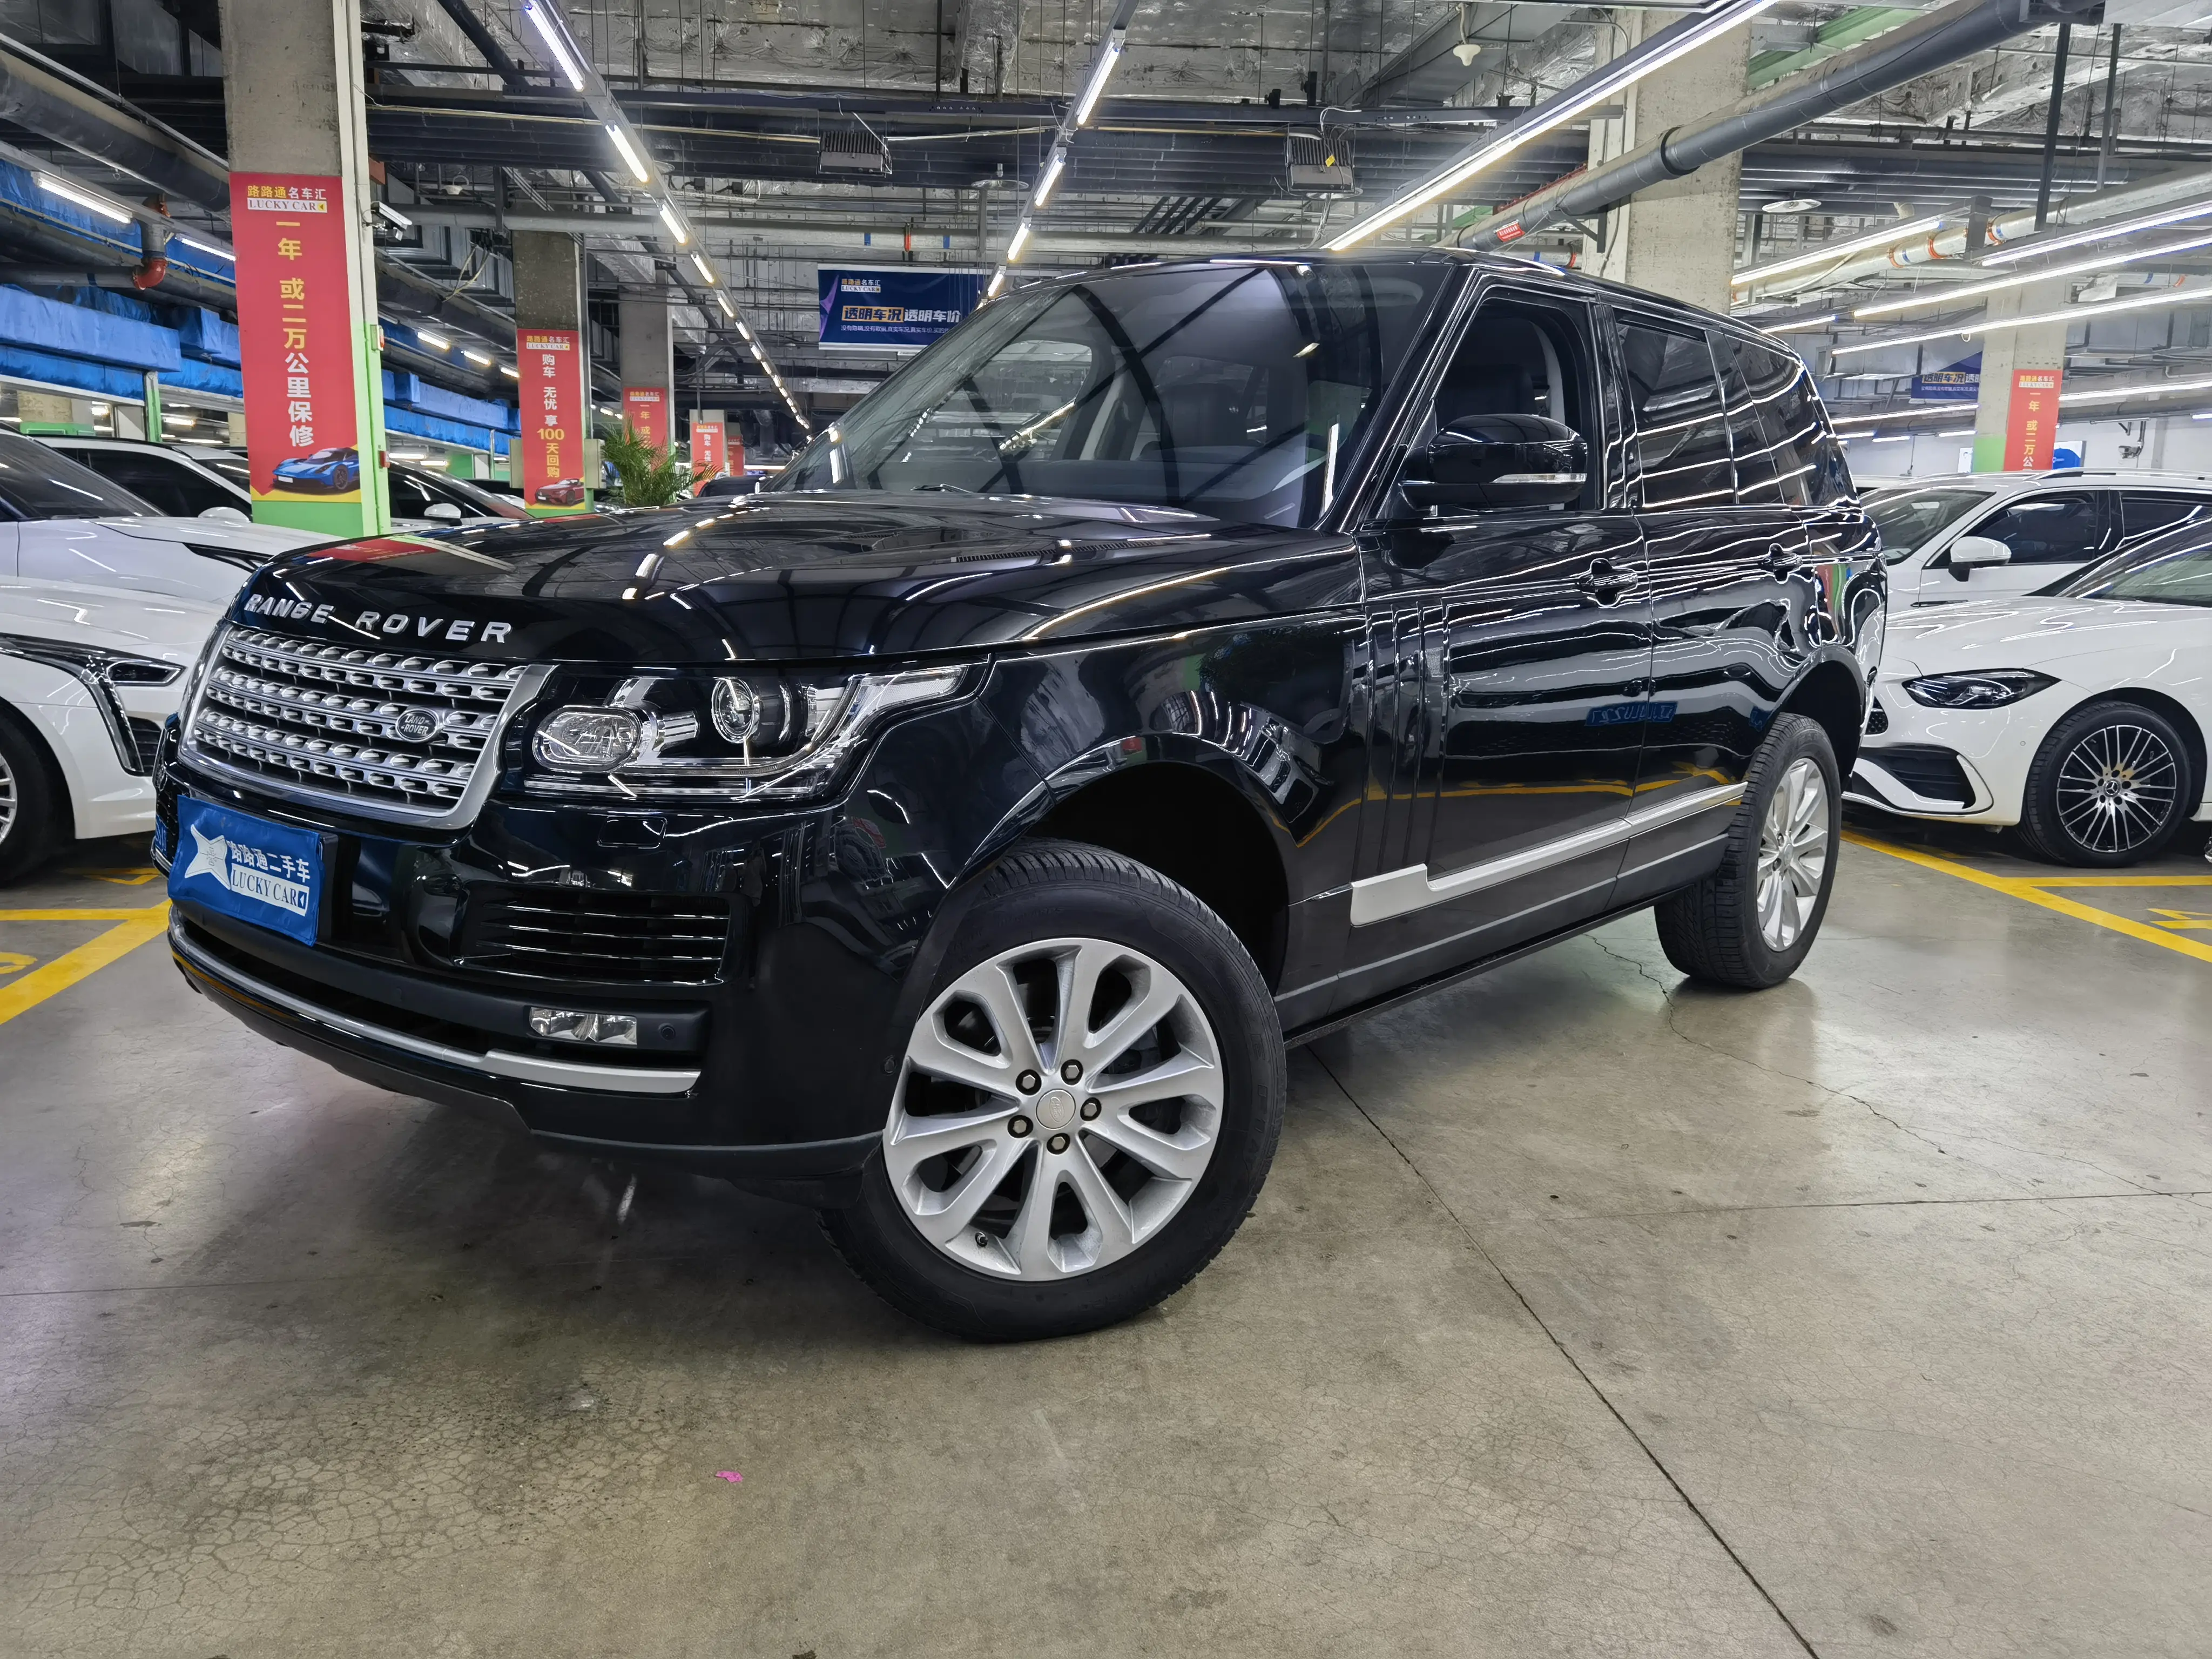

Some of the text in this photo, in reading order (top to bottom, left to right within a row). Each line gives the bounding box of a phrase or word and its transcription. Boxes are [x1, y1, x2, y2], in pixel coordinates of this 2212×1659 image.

[247, 185, 327, 200] 路路通名车汇
[249, 199, 316, 211] LUCKY CAR
[844, 307, 901, 321] 透明车况
[2022, 420, 2038, 471] 或二万公
[244, 593, 514, 644] RANGE ROVER
[404, 713, 426, 725] LAND
[403, 724, 429, 735] ROVER
[226, 840, 311, 883] 路路通二手车
[232, 869, 299, 907] LUCKY CAR
